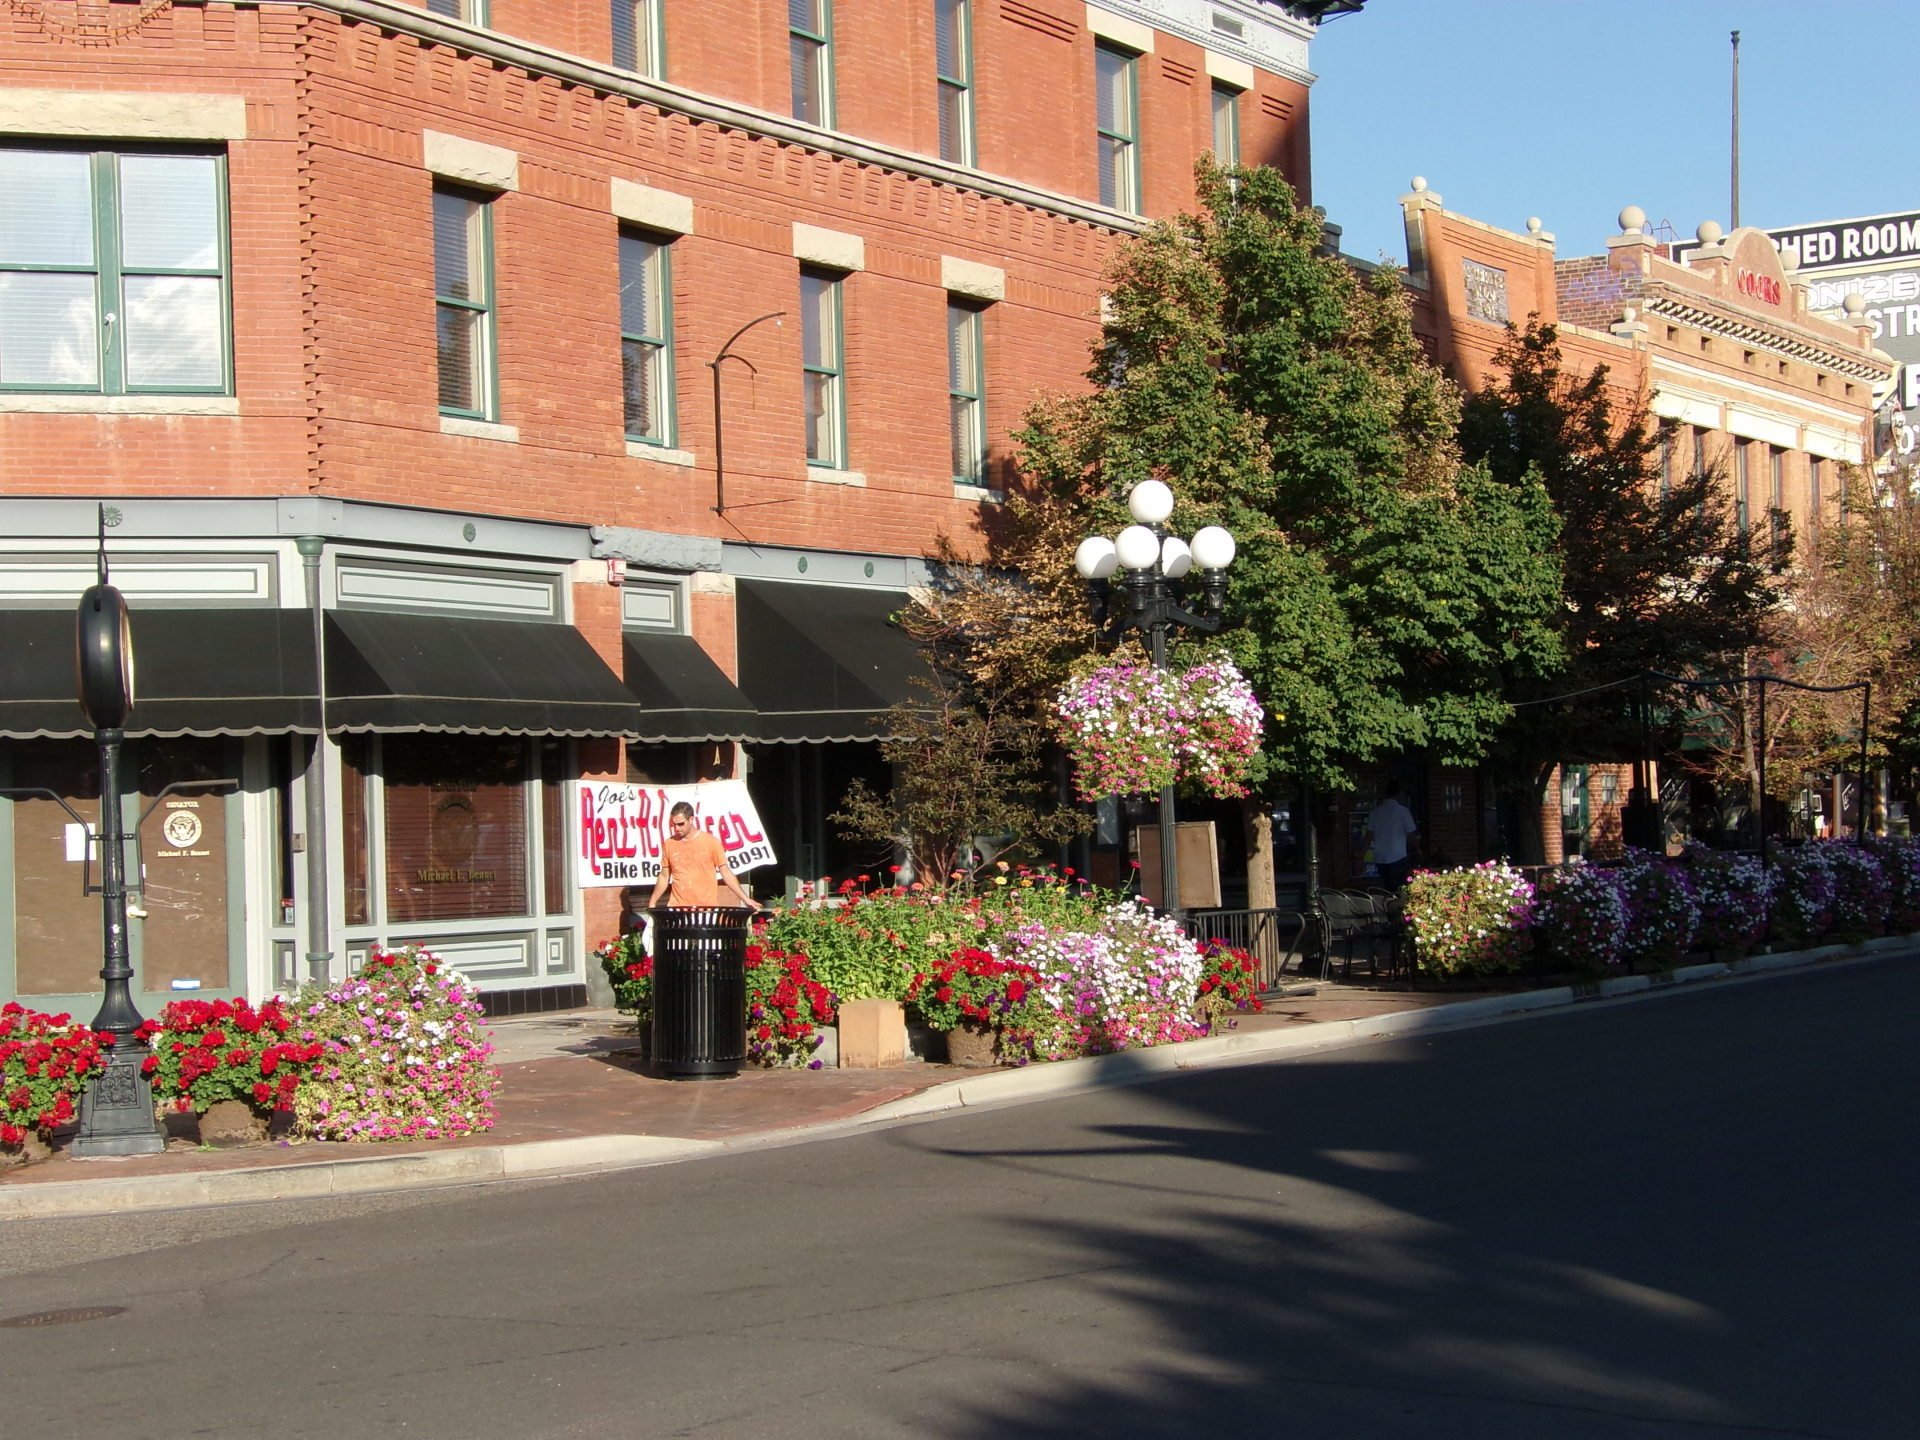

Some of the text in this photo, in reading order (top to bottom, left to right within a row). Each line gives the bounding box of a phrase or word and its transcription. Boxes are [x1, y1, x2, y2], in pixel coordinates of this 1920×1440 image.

[597, 785, 636, 813] Joe's
[417, 869, 453, 881] Michael
[603, 861, 638, 879] Bike
